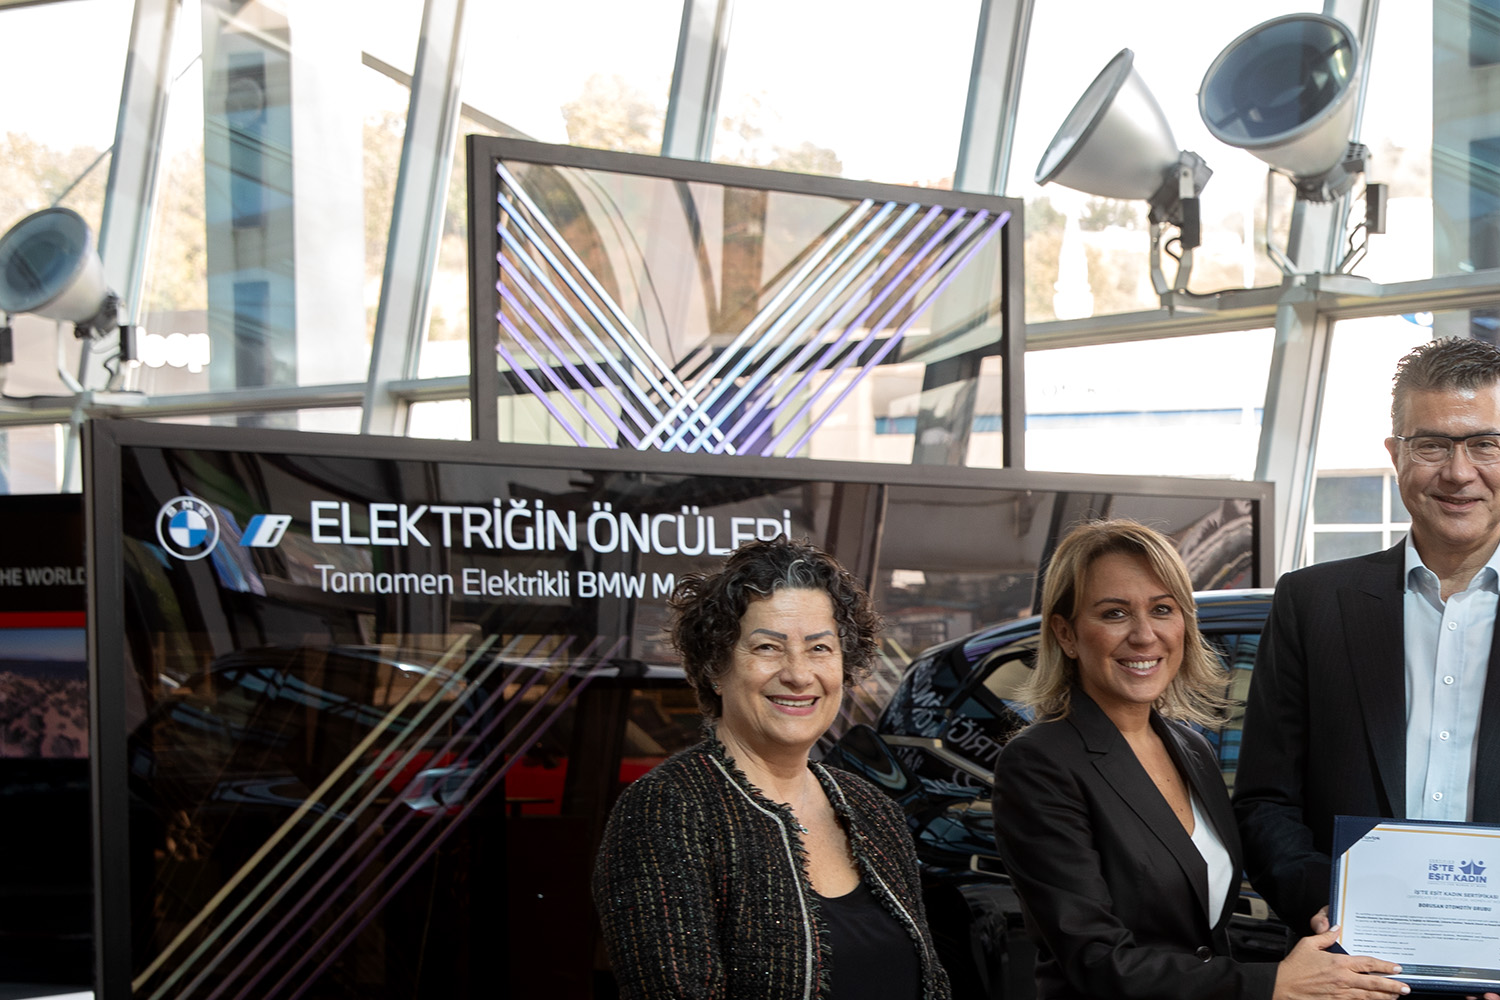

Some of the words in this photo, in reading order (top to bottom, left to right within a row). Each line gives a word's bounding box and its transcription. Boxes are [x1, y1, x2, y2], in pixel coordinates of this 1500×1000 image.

[309, 497, 578, 551] ELEKTRİĞİN
[24, 565, 86, 586] WORLD
[313, 564, 454, 595] Tamamen
[461, 567, 571, 598] Elektrikli
[578, 571, 647, 599] BMW
[652, 572, 676, 599] M
[1453, 874, 1487, 883] KADIN
